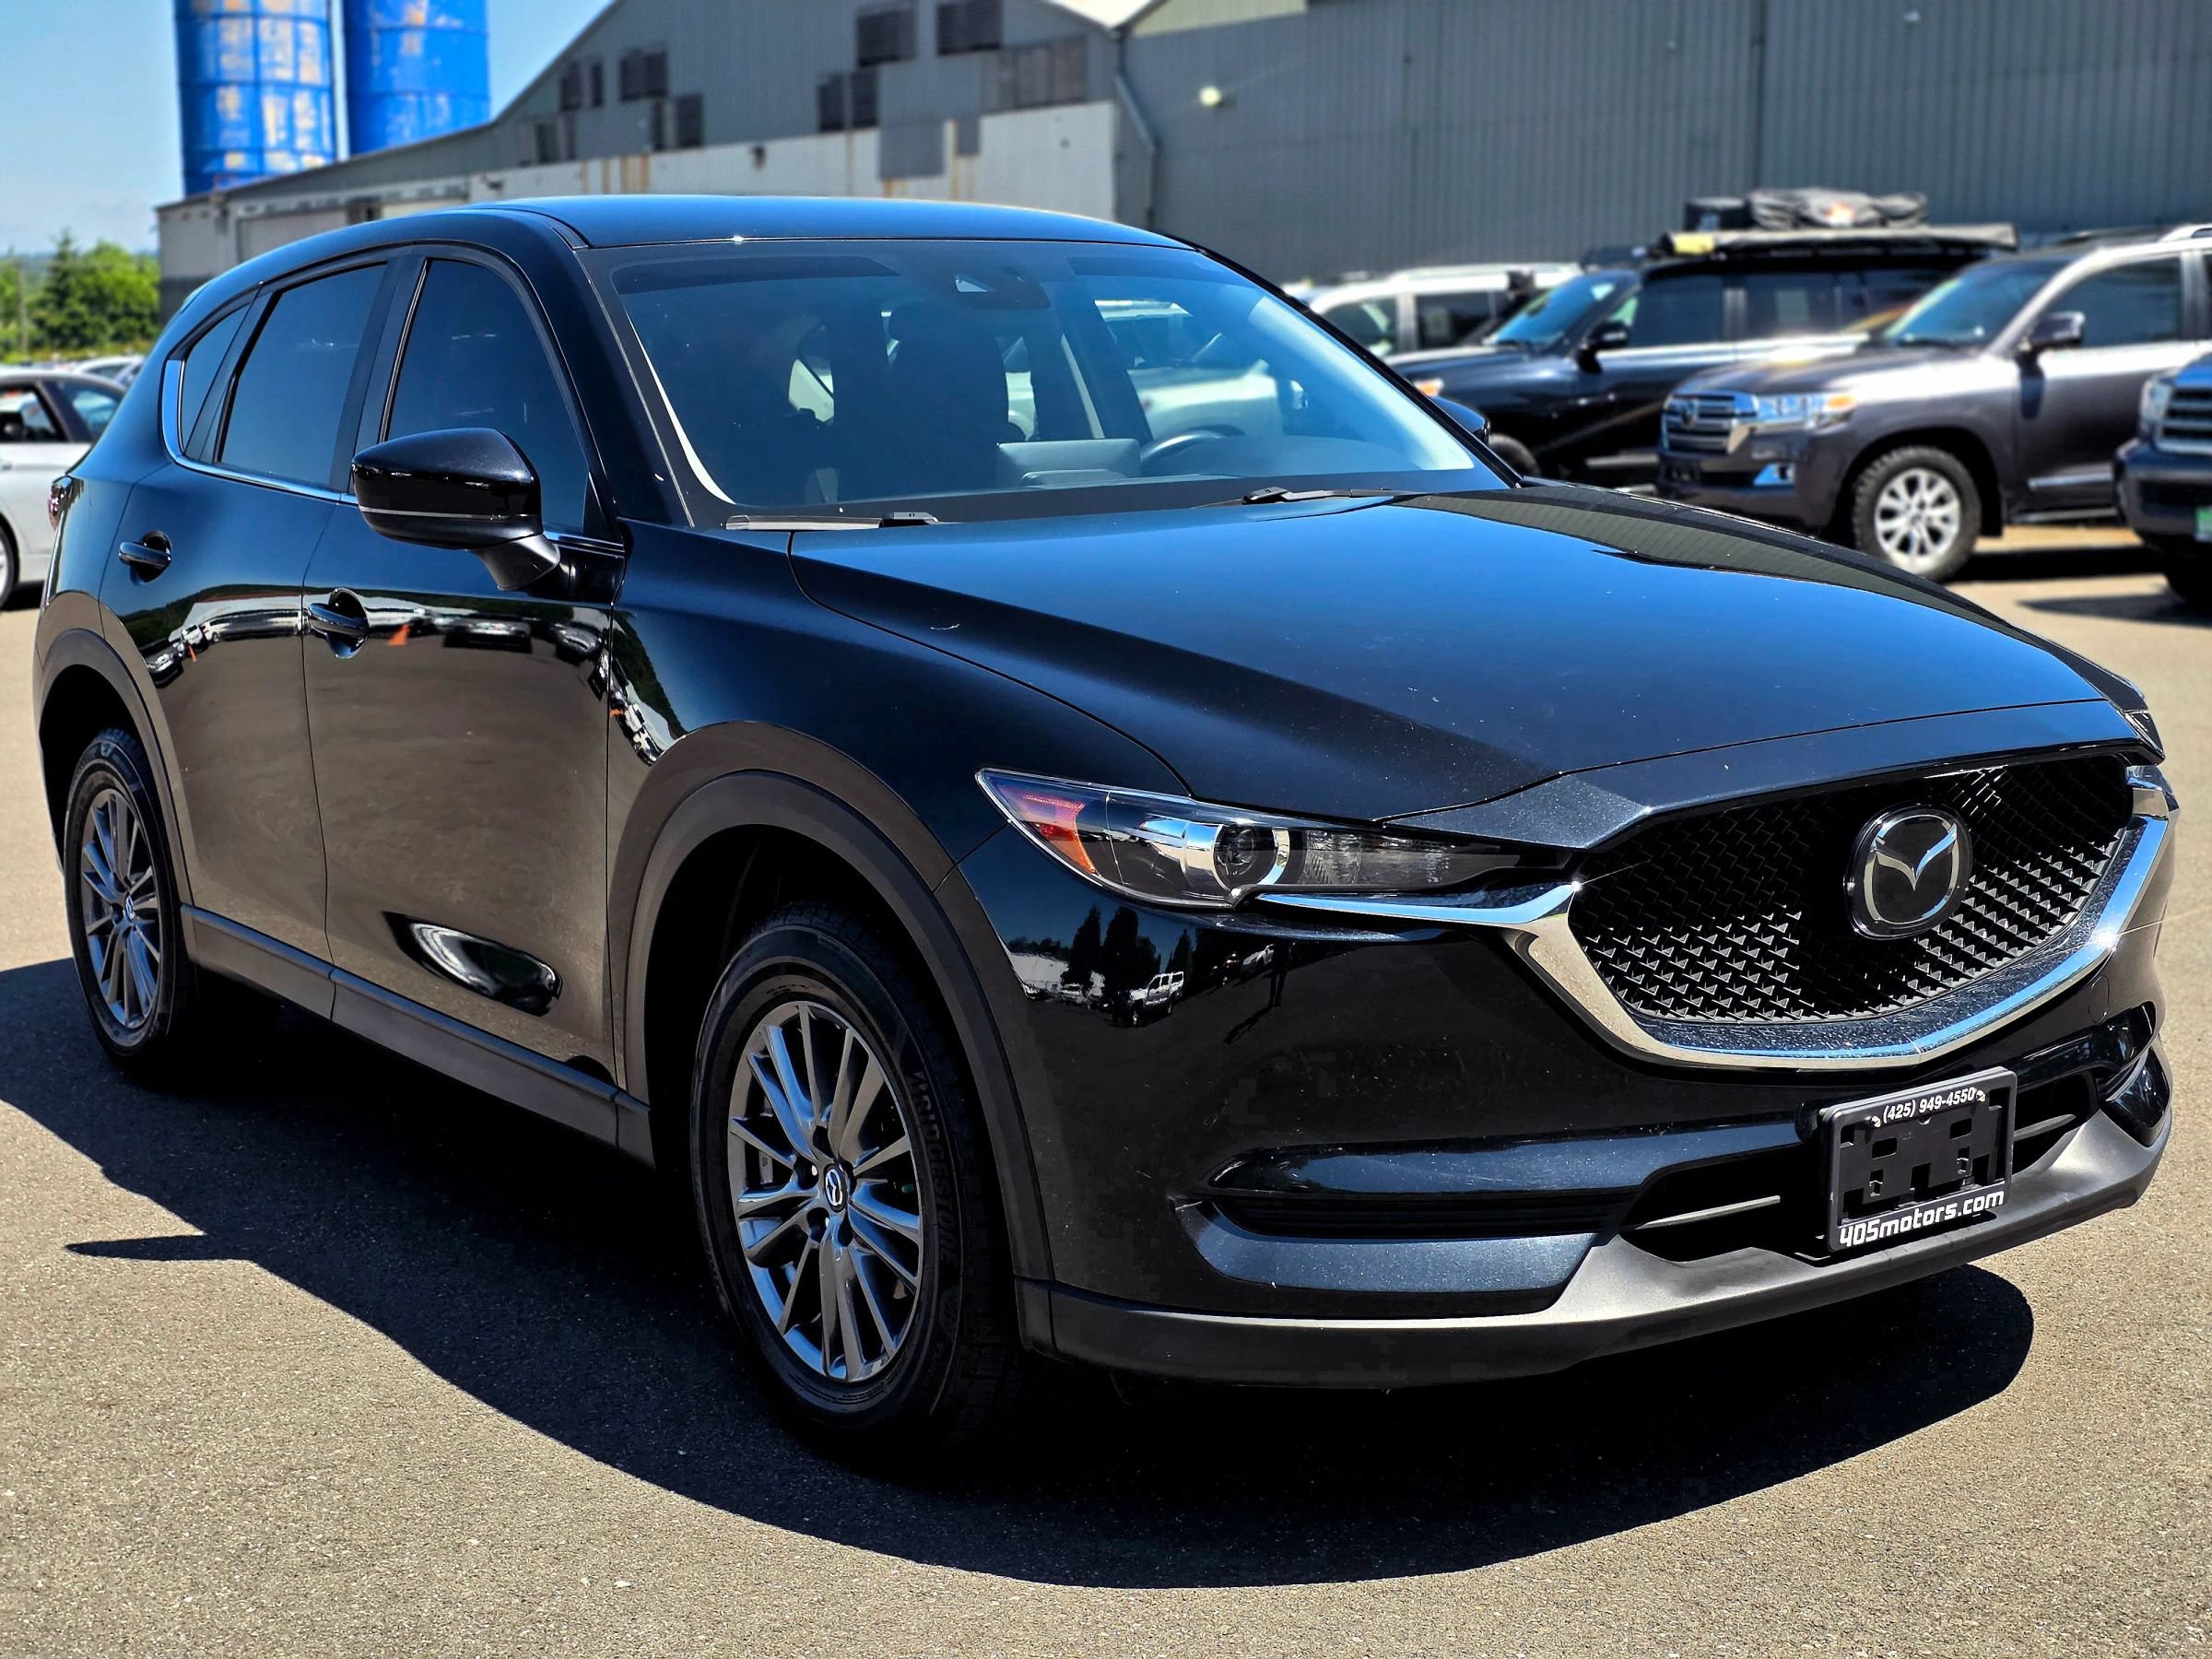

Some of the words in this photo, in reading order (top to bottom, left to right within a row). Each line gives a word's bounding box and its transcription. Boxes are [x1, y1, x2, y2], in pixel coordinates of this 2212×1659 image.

[1883, 1099, 1916, 1124] (425)
[1918, 1087, 1977, 1113] 949-4550
[1840, 1191, 2005, 1247] 405motors.com
